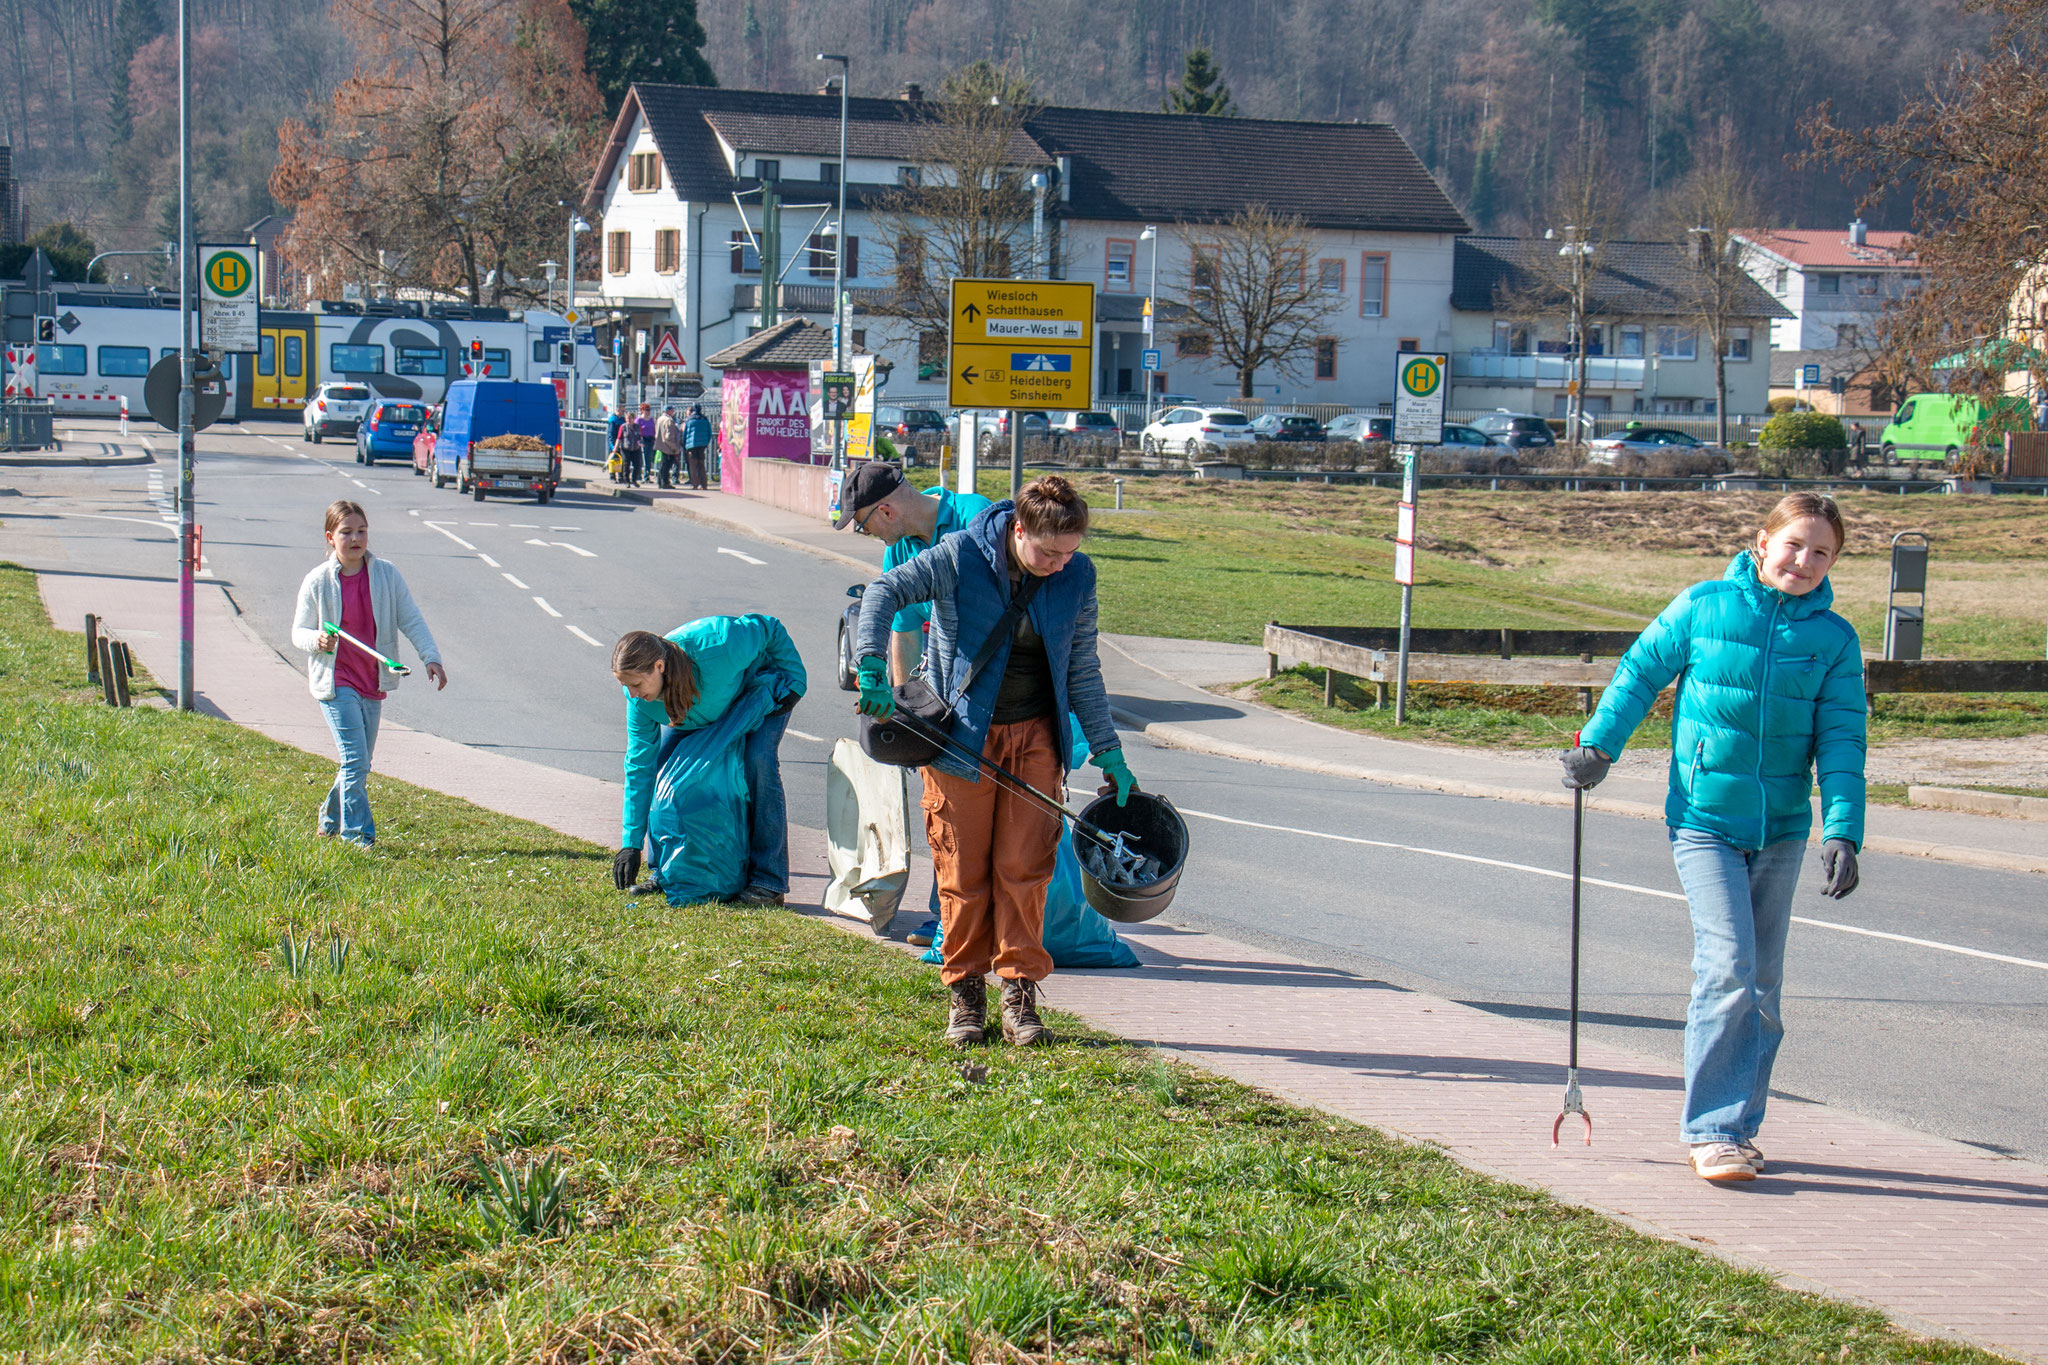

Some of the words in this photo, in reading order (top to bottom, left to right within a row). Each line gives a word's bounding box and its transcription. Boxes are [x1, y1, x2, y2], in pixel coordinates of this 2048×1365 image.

[219, 261, 238, 288] H
[987, 290, 1038, 301] Wiesloch
[986, 304, 1064, 316] Schatthausen
[989, 323, 1058, 335] Mauer-West
[989, 372, 1000, 380] 45
[1010, 375, 1072, 389] Heidelberg
[1413, 366, 1429, 389] H
[1010, 390, 1062, 401] Sinsheim
[756, 417, 786, 426] FUNDORT
[789, 419, 805, 429] DES
[756, 427, 775, 436] HOMO
[776, 427, 811, 439] HEIDELB
